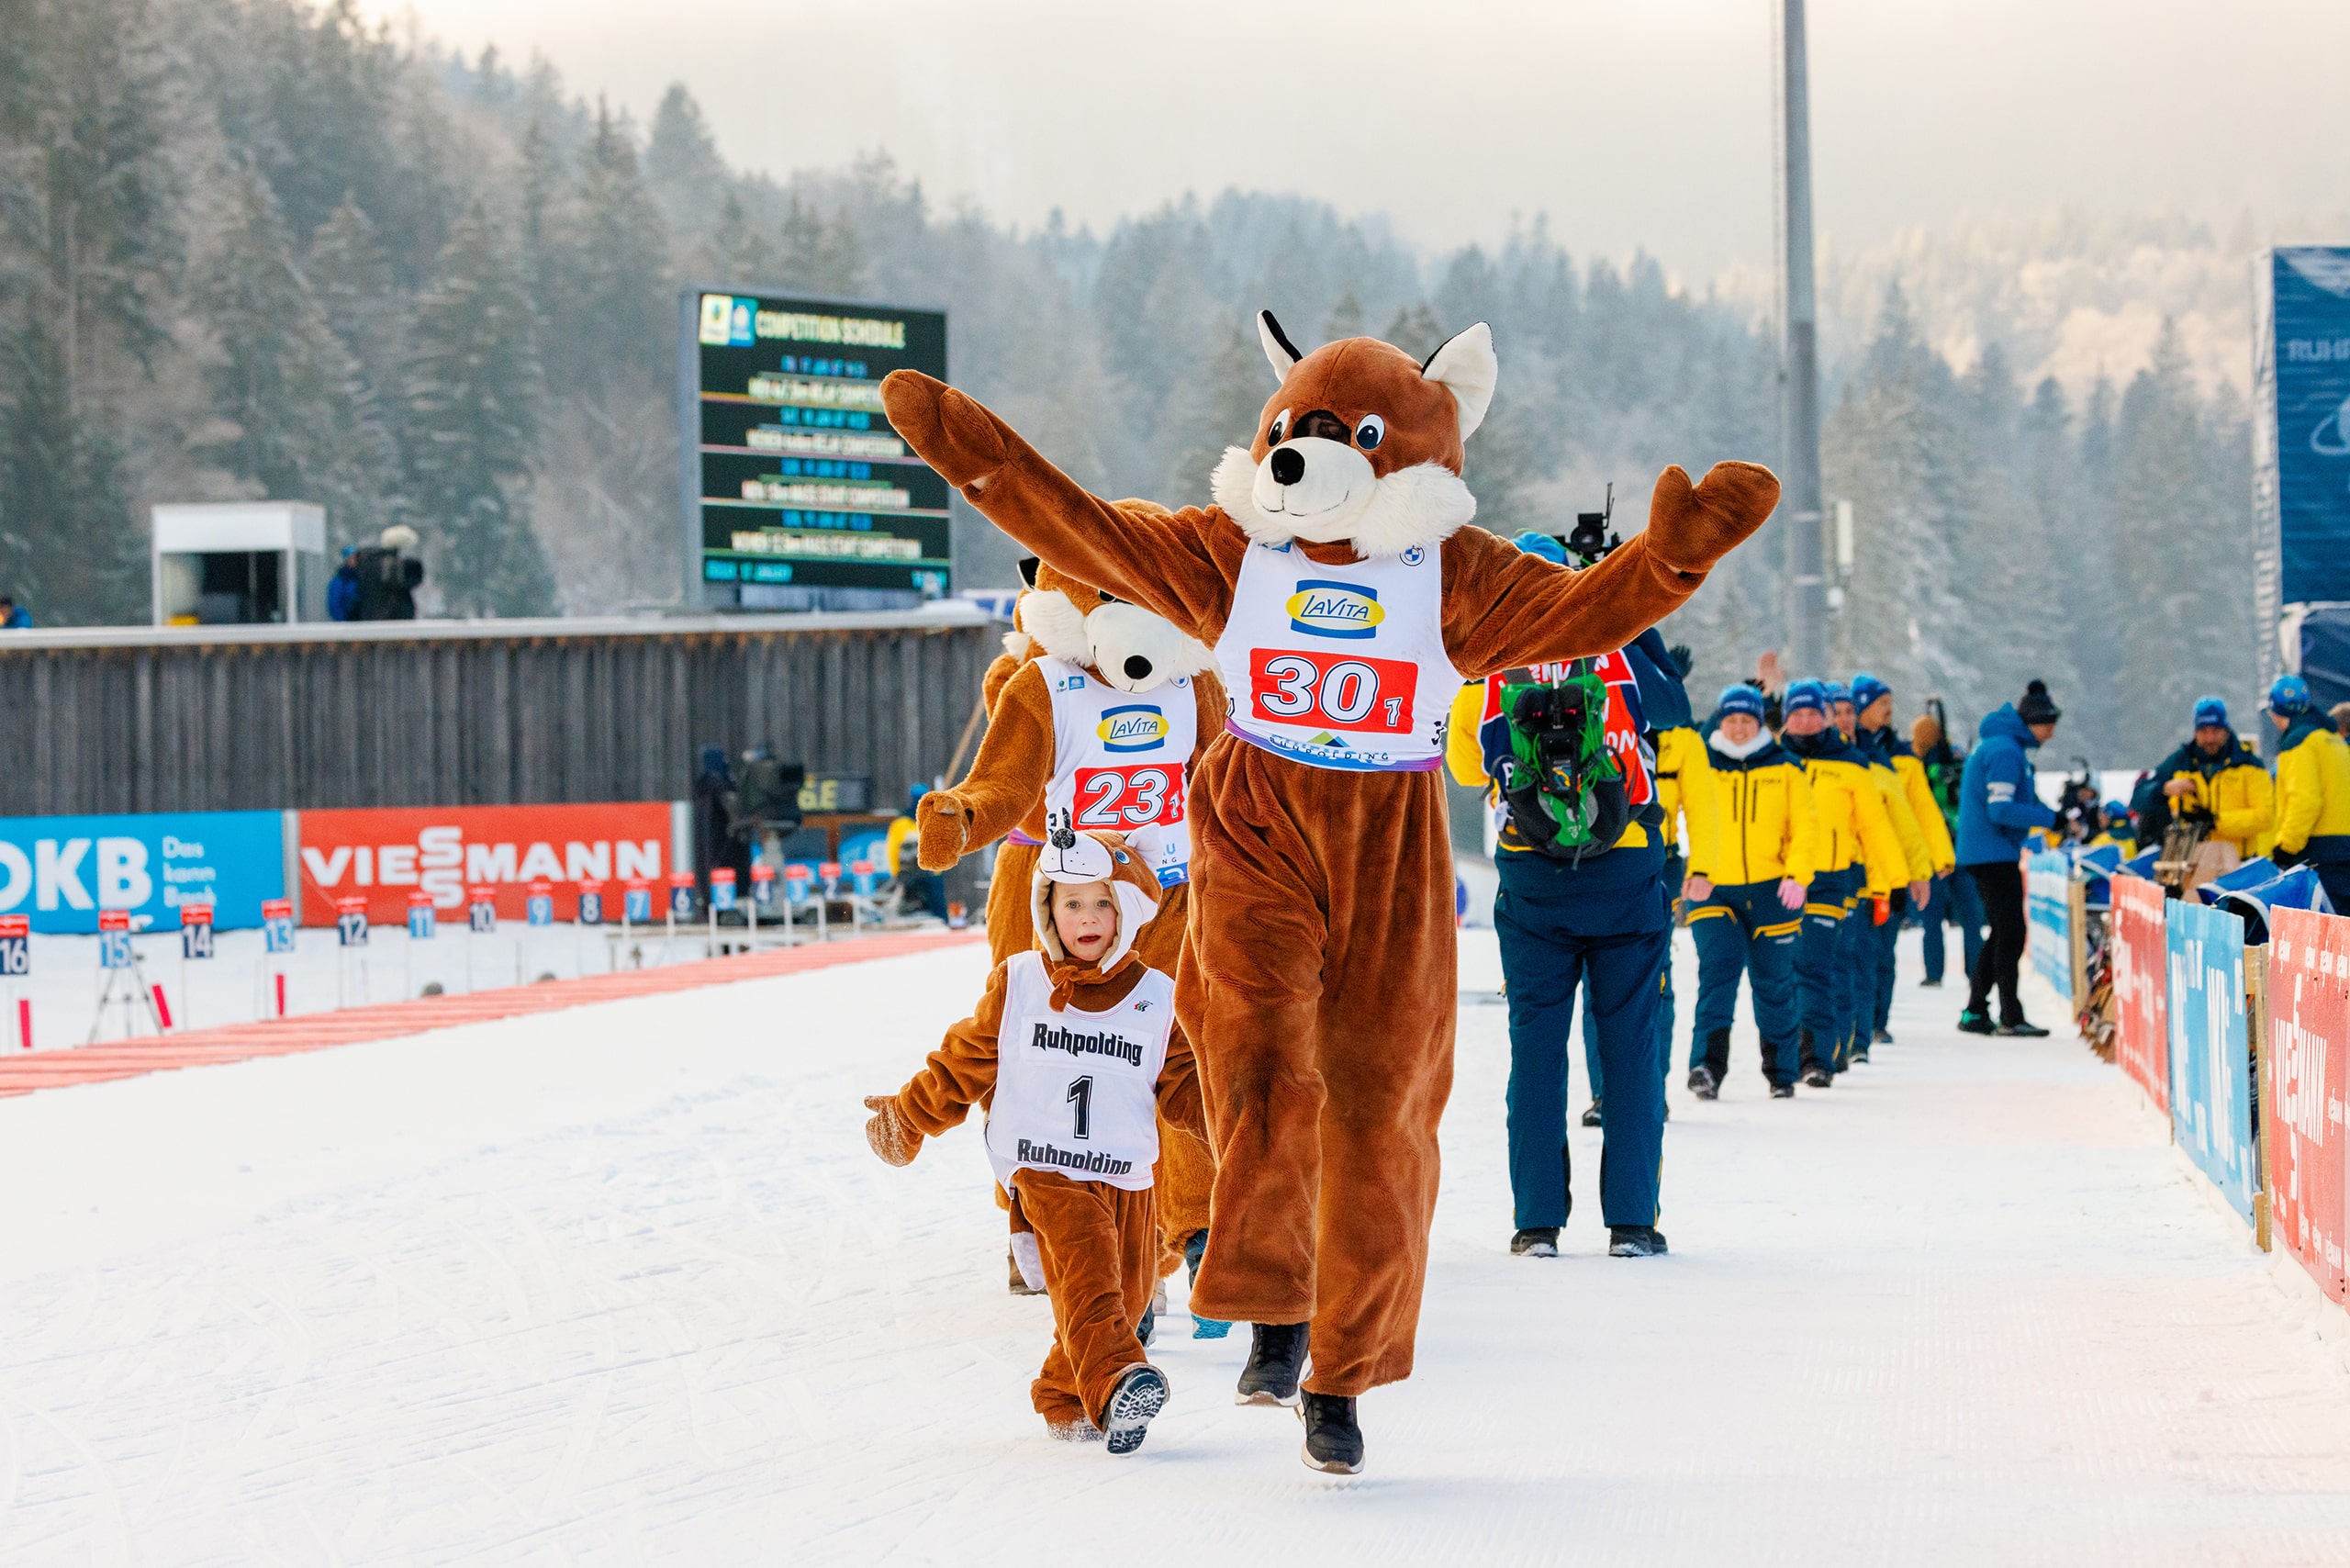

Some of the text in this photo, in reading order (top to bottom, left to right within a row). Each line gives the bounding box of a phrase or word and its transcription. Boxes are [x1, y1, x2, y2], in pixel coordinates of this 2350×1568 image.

[1260, 655, 1380, 723] 30
[1078, 768, 1169, 824] 23
[162, 835, 205, 858] Das
[300, 825, 661, 909] VIESSMANN
[470, 902, 495, 932] 10
[532, 898, 549, 924] 9
[581, 894, 599, 923] 8
[634, 891, 648, 919] 7
[675, 888, 691, 913] 6
[266, 918, 294, 952] 13
[339, 913, 368, 945] 12
[410, 908, 434, 938] 11
[0, 937, 28, 974] 16
[102, 930, 129, 967] 15
[186, 924, 212, 958] 14
[1031, 1023, 1144, 1068] Ruhpolding
[1066, 1074, 1093, 1140] 1
